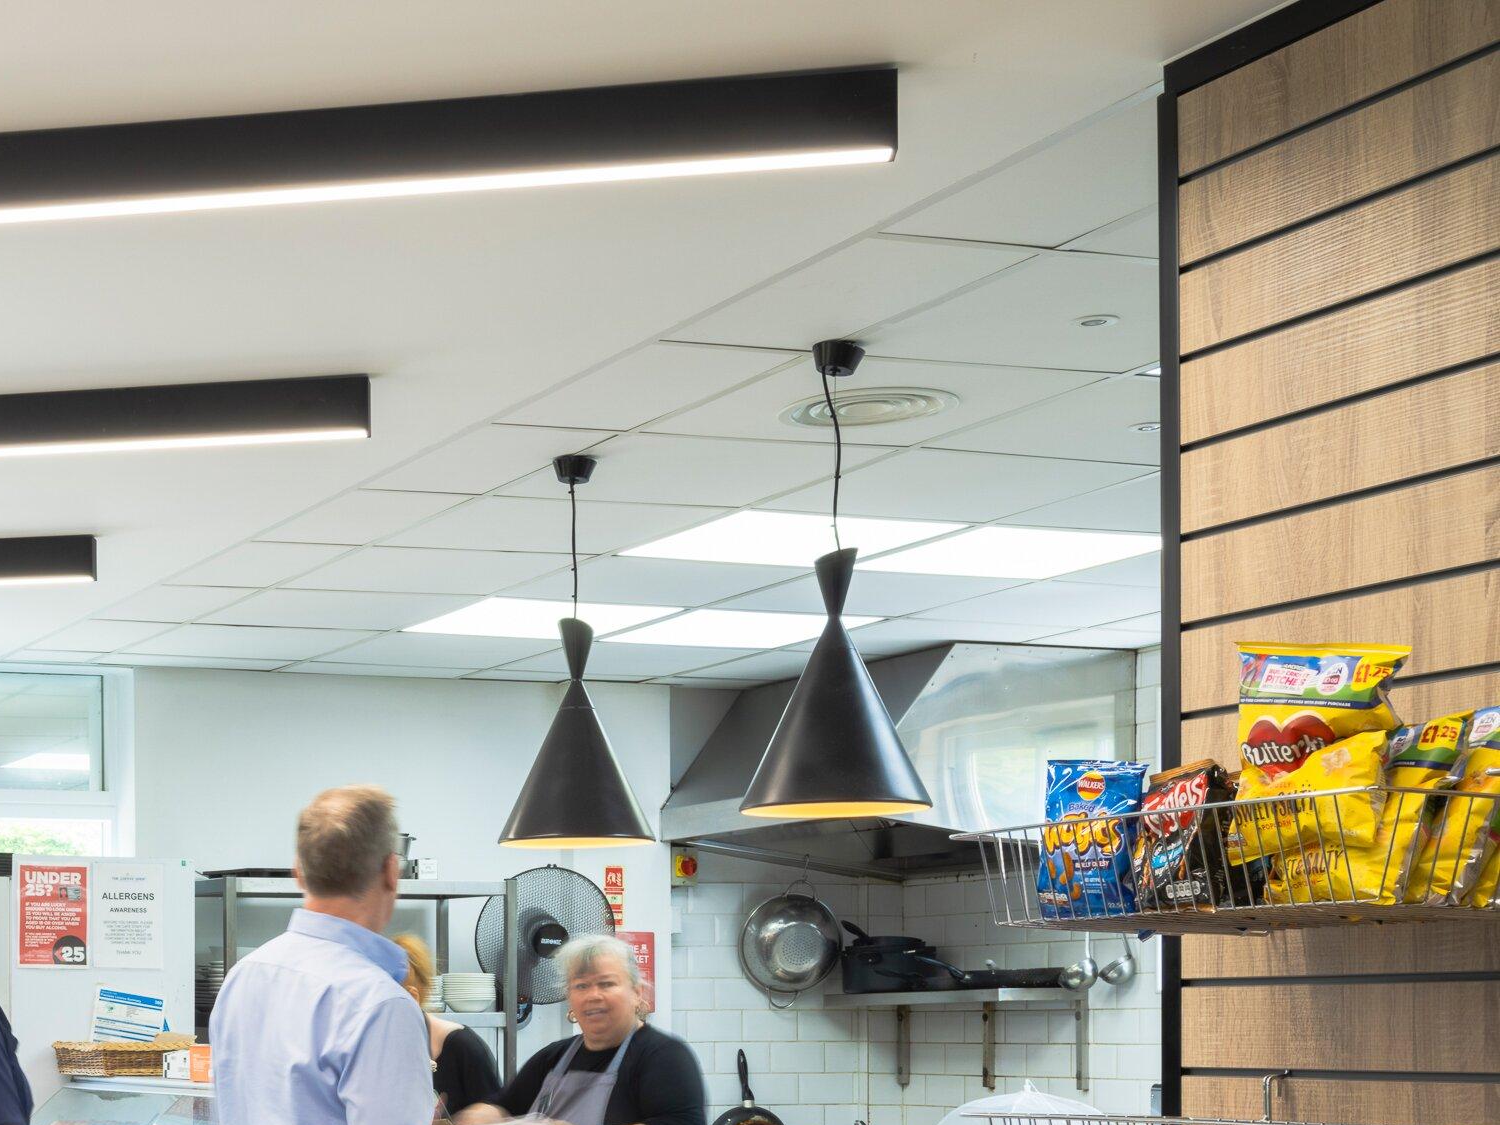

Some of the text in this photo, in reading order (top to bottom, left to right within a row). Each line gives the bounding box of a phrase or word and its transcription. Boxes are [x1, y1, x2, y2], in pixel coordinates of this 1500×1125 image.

[1355, 664, 1393, 683] £1.25
[1421, 724, 1457, 744] £1.25
[1077, 780, 1105, 790] WALKERS
[1068, 802, 1095, 813] Baked
[25, 871, 82, 885] UNDER
[25, 884, 54, 896] 25?
[102, 892, 154, 900] ALLERGENS
[62, 946, 85, 962] 25
